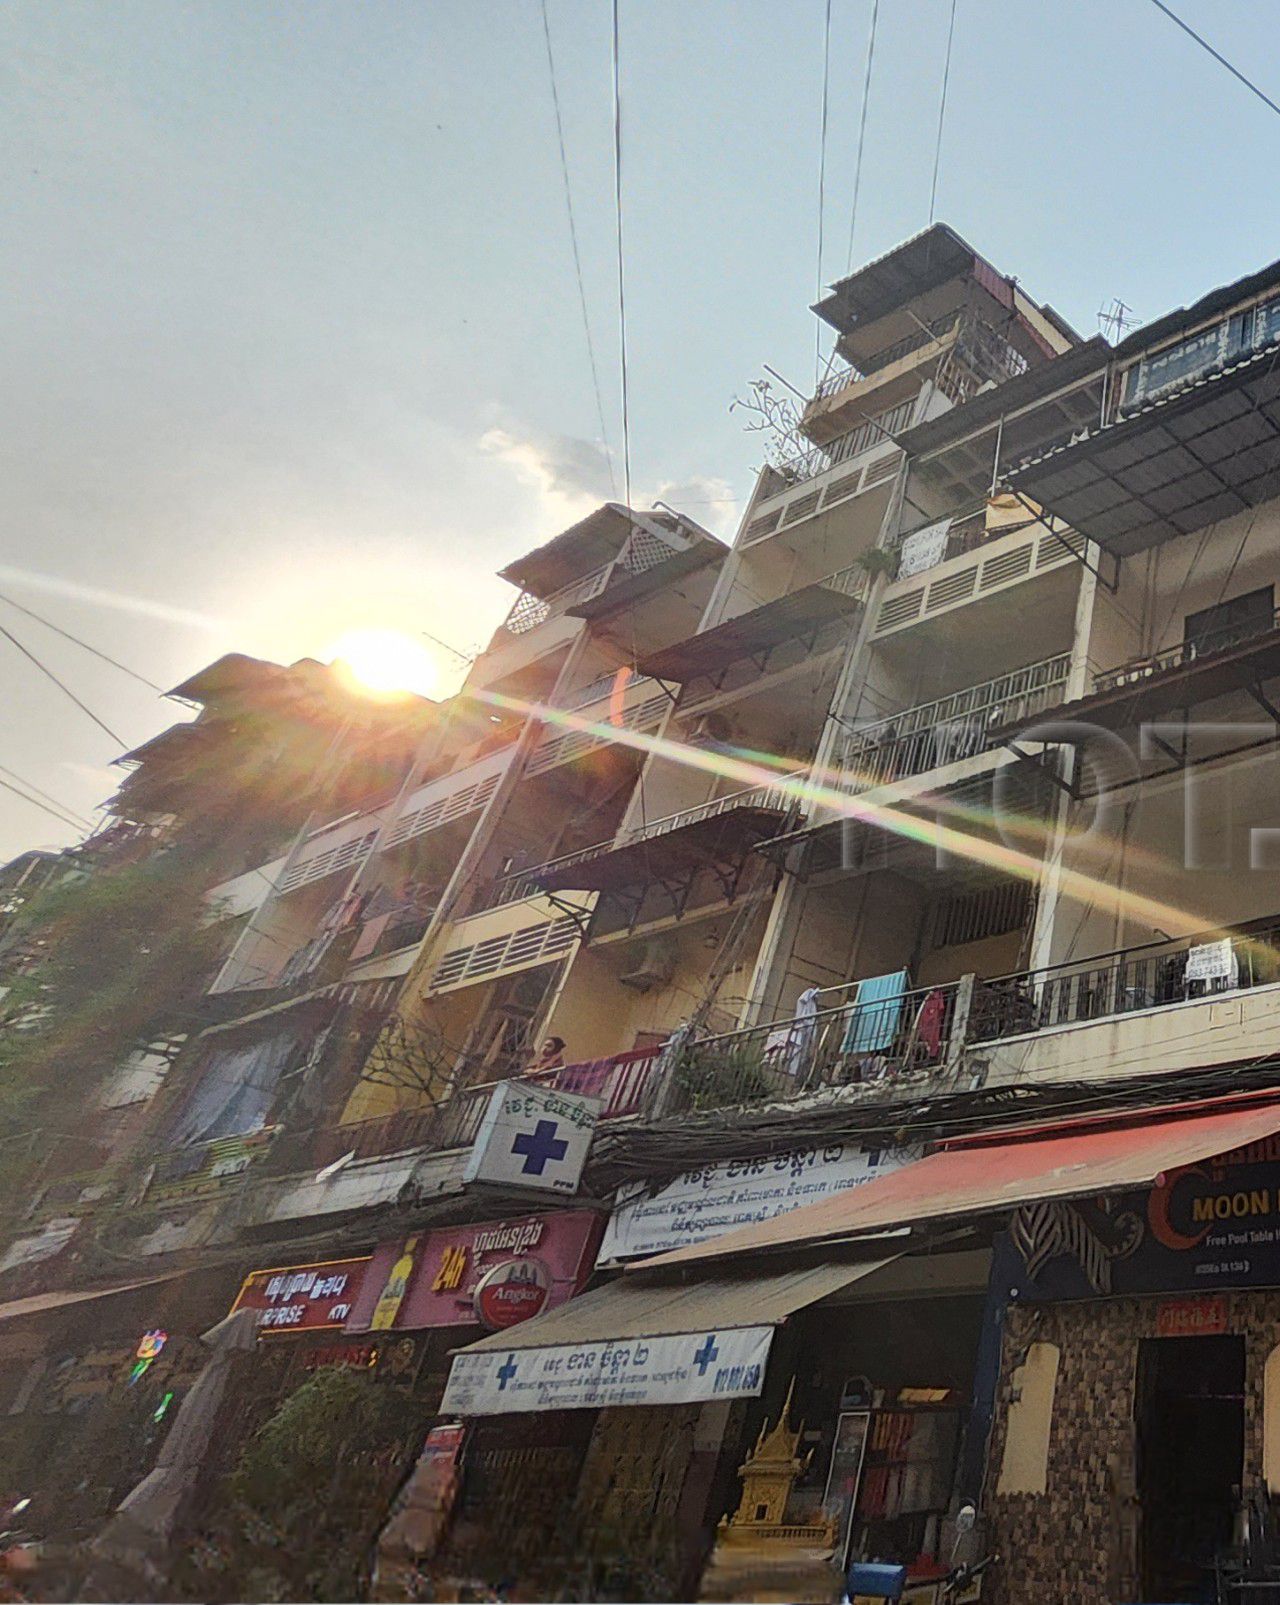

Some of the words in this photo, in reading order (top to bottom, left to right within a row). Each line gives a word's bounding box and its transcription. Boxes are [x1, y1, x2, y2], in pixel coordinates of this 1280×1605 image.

[1192, 1189, 1269, 1222] MOON
[1206, 1234, 1226, 1247] Free
[1228, 1230, 1248, 1245] Pool
[1250, 1228, 1273, 1243] Table
[431, 1245, 466, 1292] 24h
[327, 1303, 352, 1320] KTV
